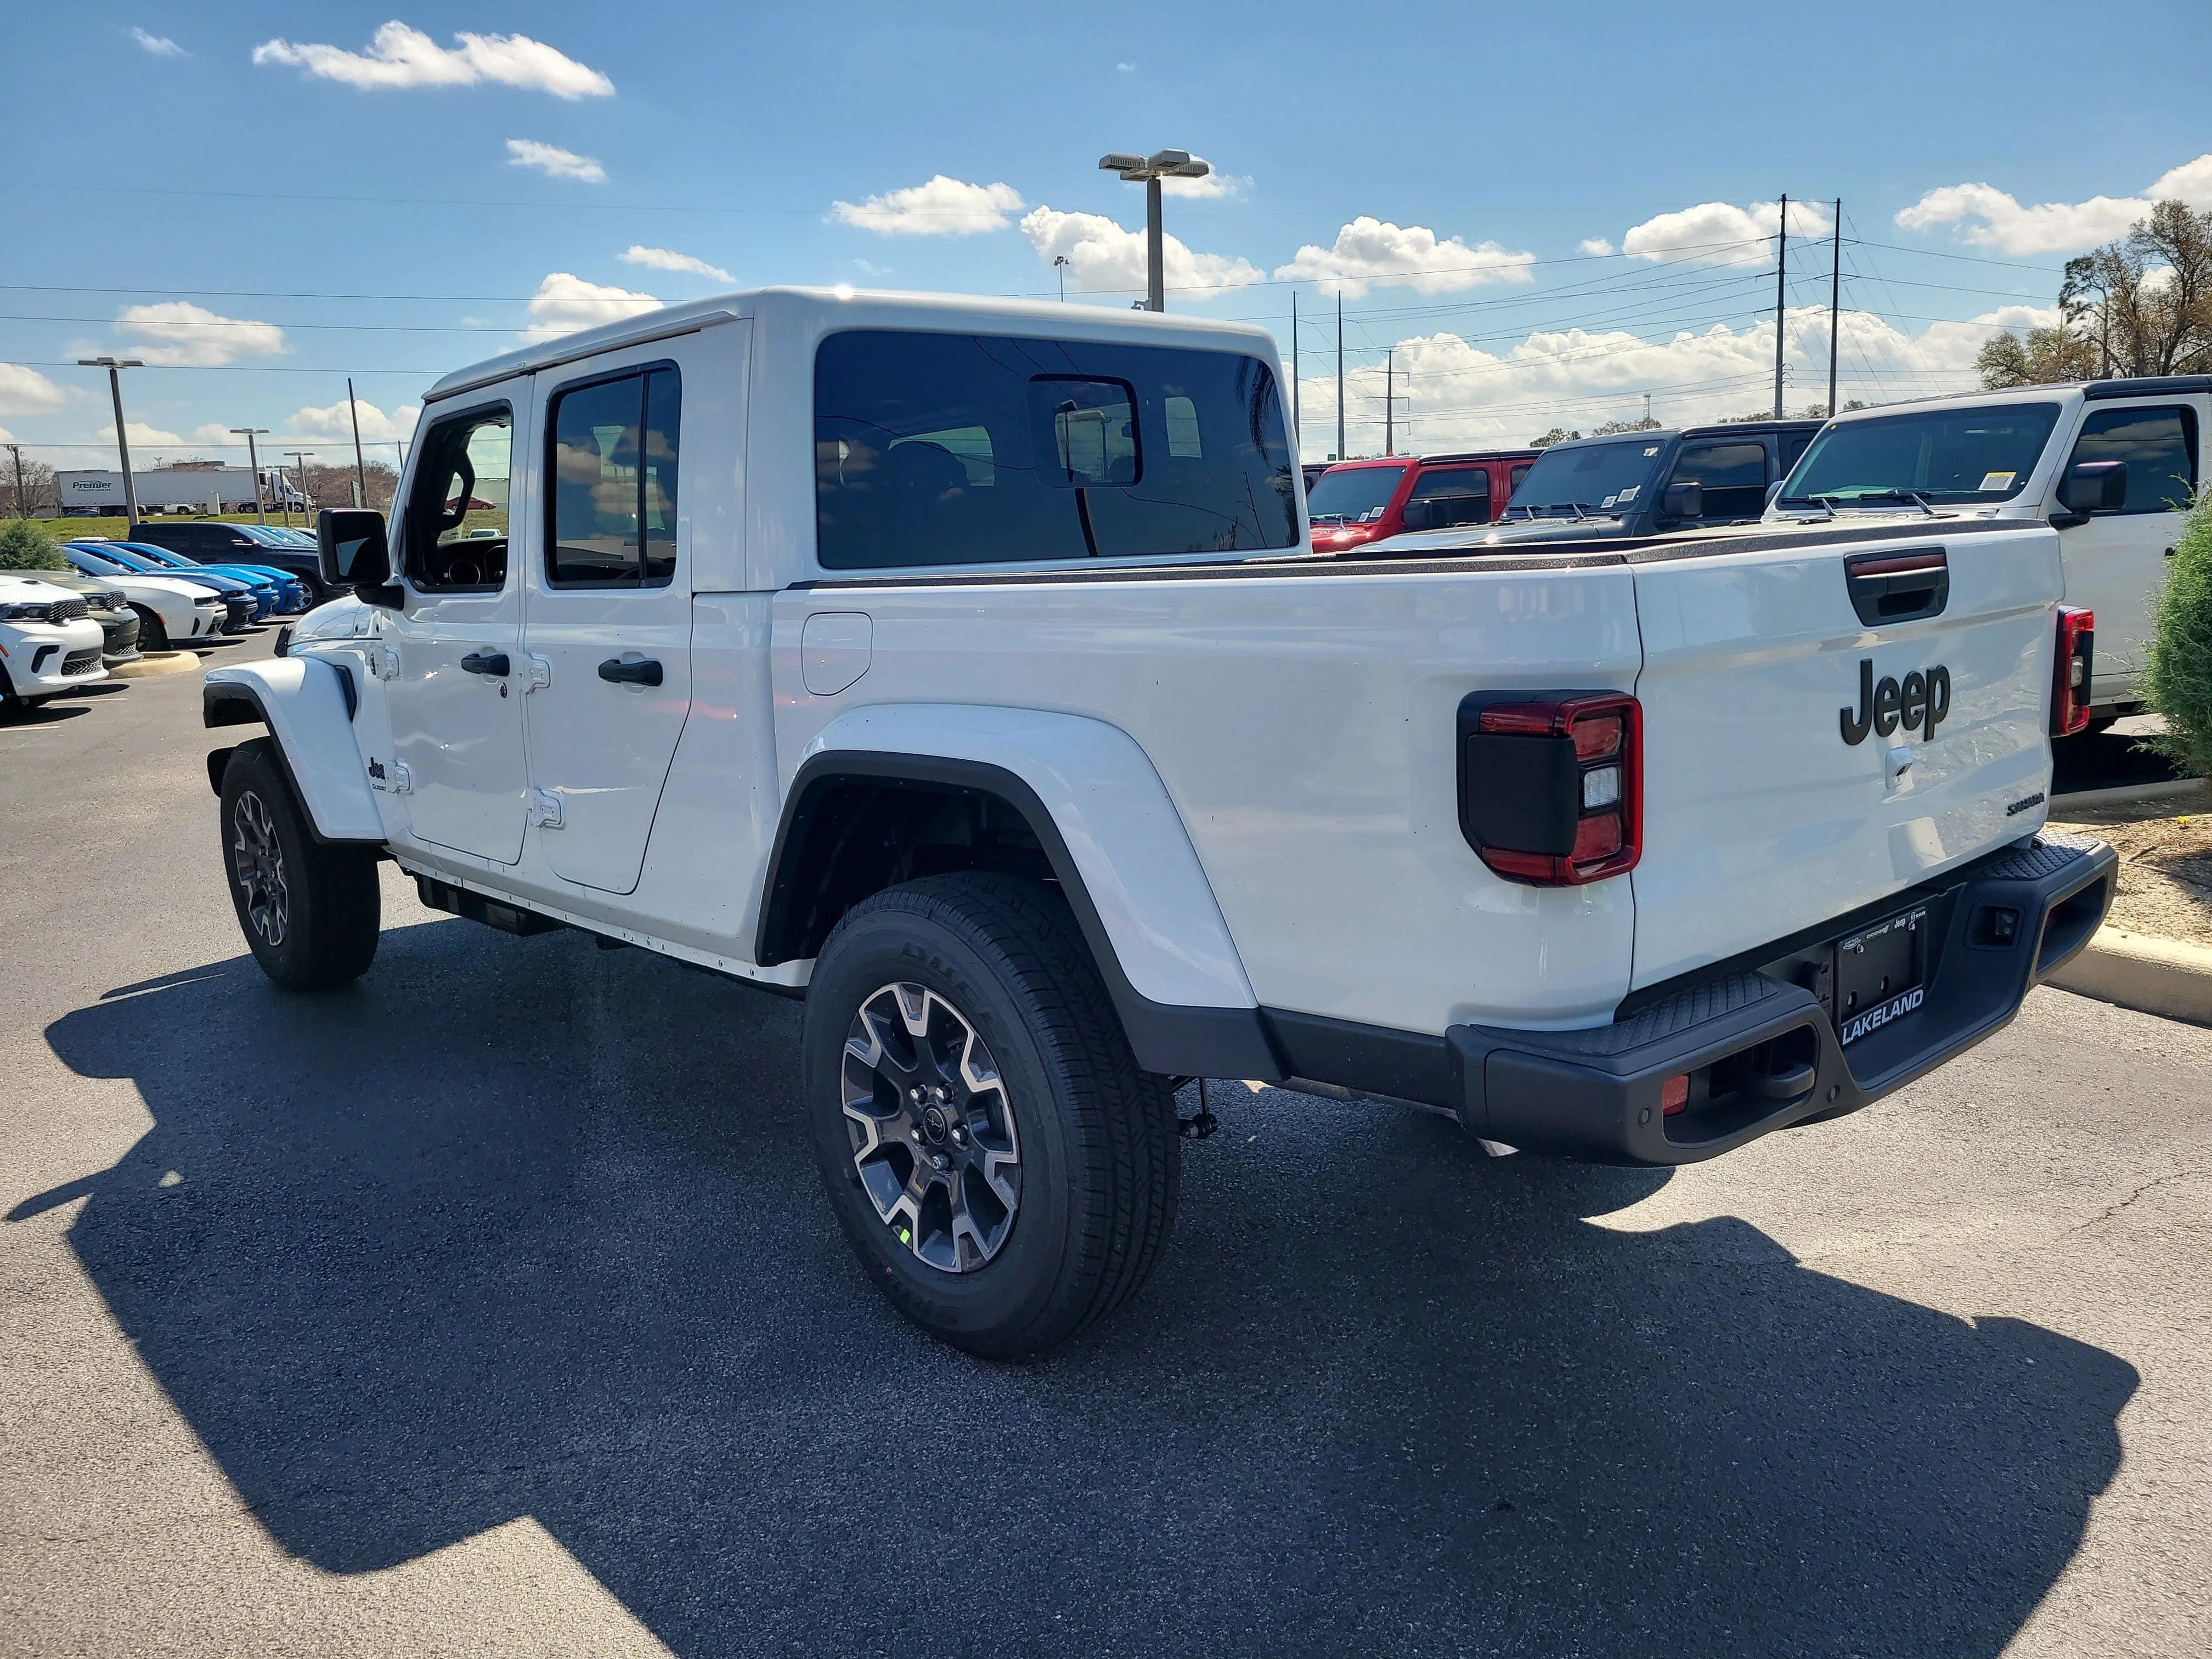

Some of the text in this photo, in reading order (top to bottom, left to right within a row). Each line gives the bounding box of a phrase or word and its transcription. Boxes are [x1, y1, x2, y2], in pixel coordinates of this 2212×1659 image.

[1840, 658, 1951, 746] Jeep
[2006, 792, 2045, 817] SAHARA
[1866, 927, 1886, 939] DODGE
[1894, 918, 1906, 929] Jeep
[1842, 989, 1924, 1046] LAKELAND
